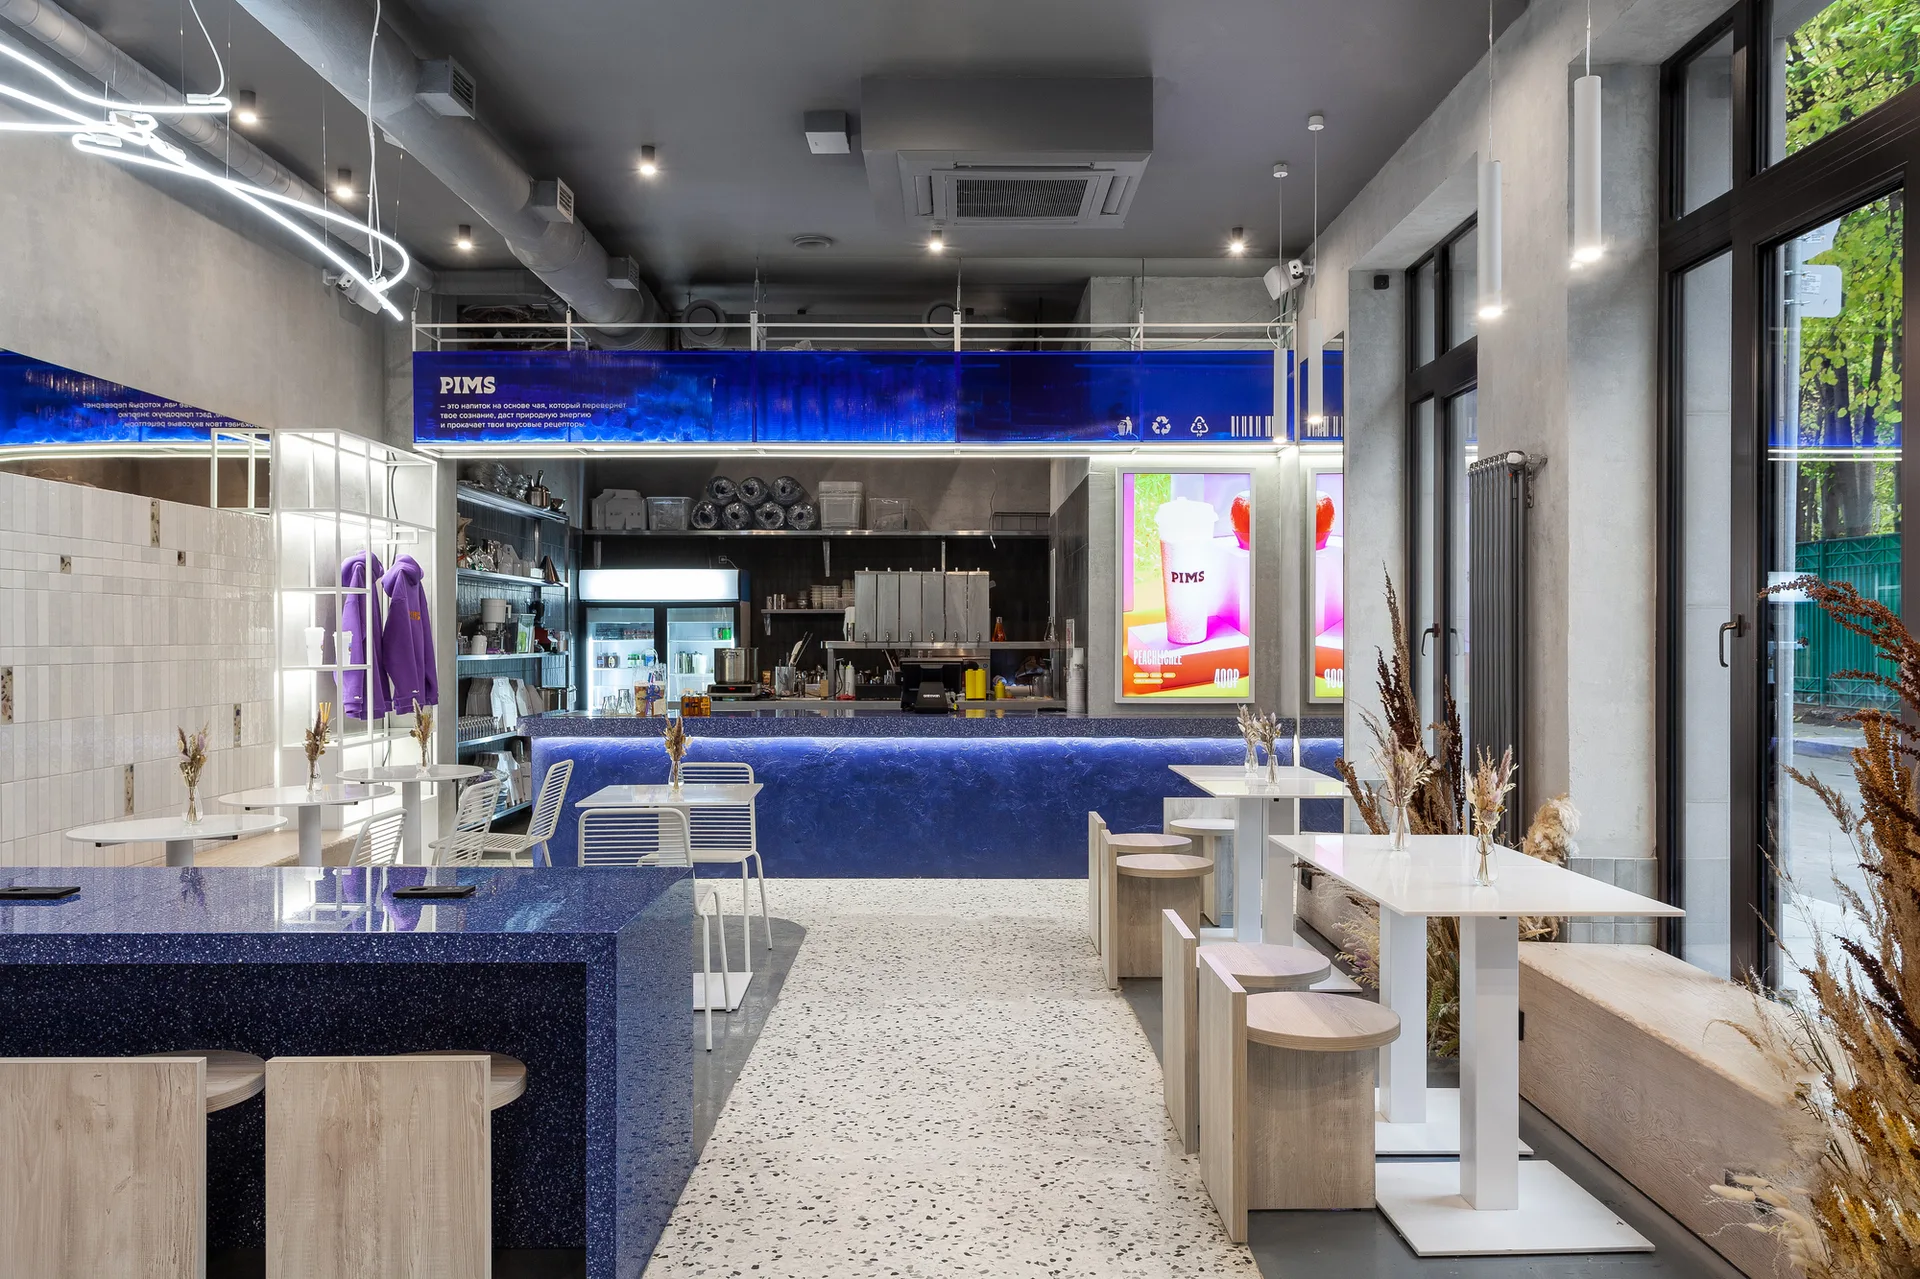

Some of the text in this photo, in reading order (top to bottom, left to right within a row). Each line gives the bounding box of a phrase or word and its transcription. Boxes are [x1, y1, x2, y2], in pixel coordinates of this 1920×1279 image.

[440, 376, 496, 394] PIMS
[549, 402, 581, 410] который
[516, 413, 558, 421] природную
[506, 422, 542, 430] вкусовые
[543, 421, 586, 429] рецепторы.
[1197, 422, 1202, 430] 5
[1171, 570, 1205, 583] PIMS
